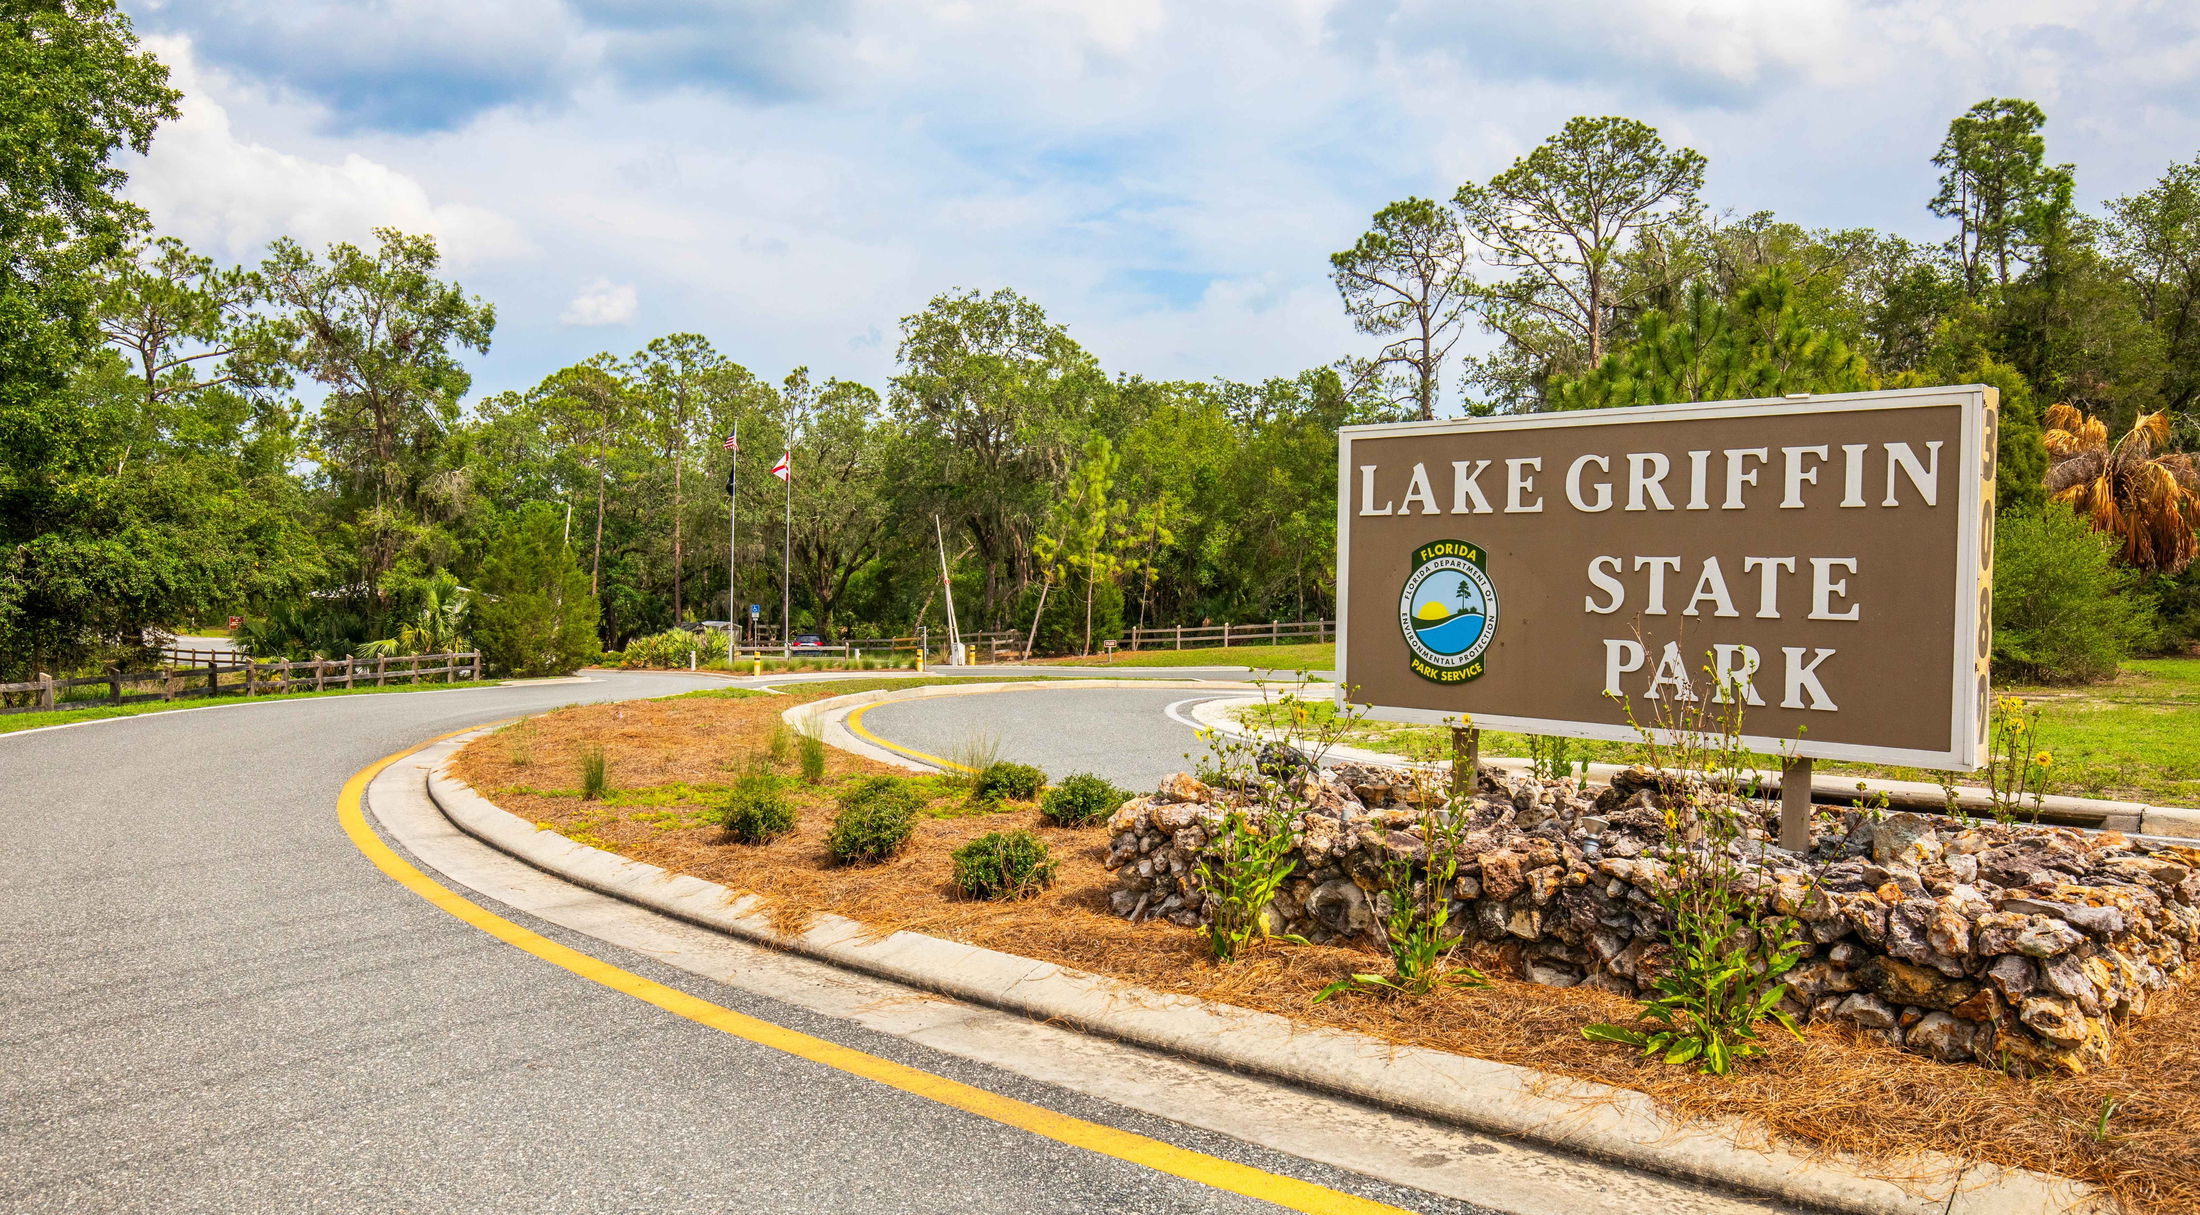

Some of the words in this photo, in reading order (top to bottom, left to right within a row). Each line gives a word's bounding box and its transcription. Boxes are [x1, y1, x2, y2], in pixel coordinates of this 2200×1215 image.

[1359, 456, 1543, 516] LAKE
[1565, 441, 1943, 513] GRIFFIN
[1404, 566, 1431, 600] FLORIDA
[1434, 559, 1487, 587] DEPARTMENT
[1485, 590, 1494, 602] OF
[1420, 543, 1476, 562] FLORIDA
[1977, 408, 1996, 745] 3089
[1585, 555, 1860, 621] STATE
[1401, 612, 1455, 665] ENVIRONMENTAL
[1458, 615, 1495, 664] PROTECTION
[1411, 659, 1438, 680] PARK
[1441, 662, 1483, 682] SERVICE
[1602, 639, 1838, 712] PARK
